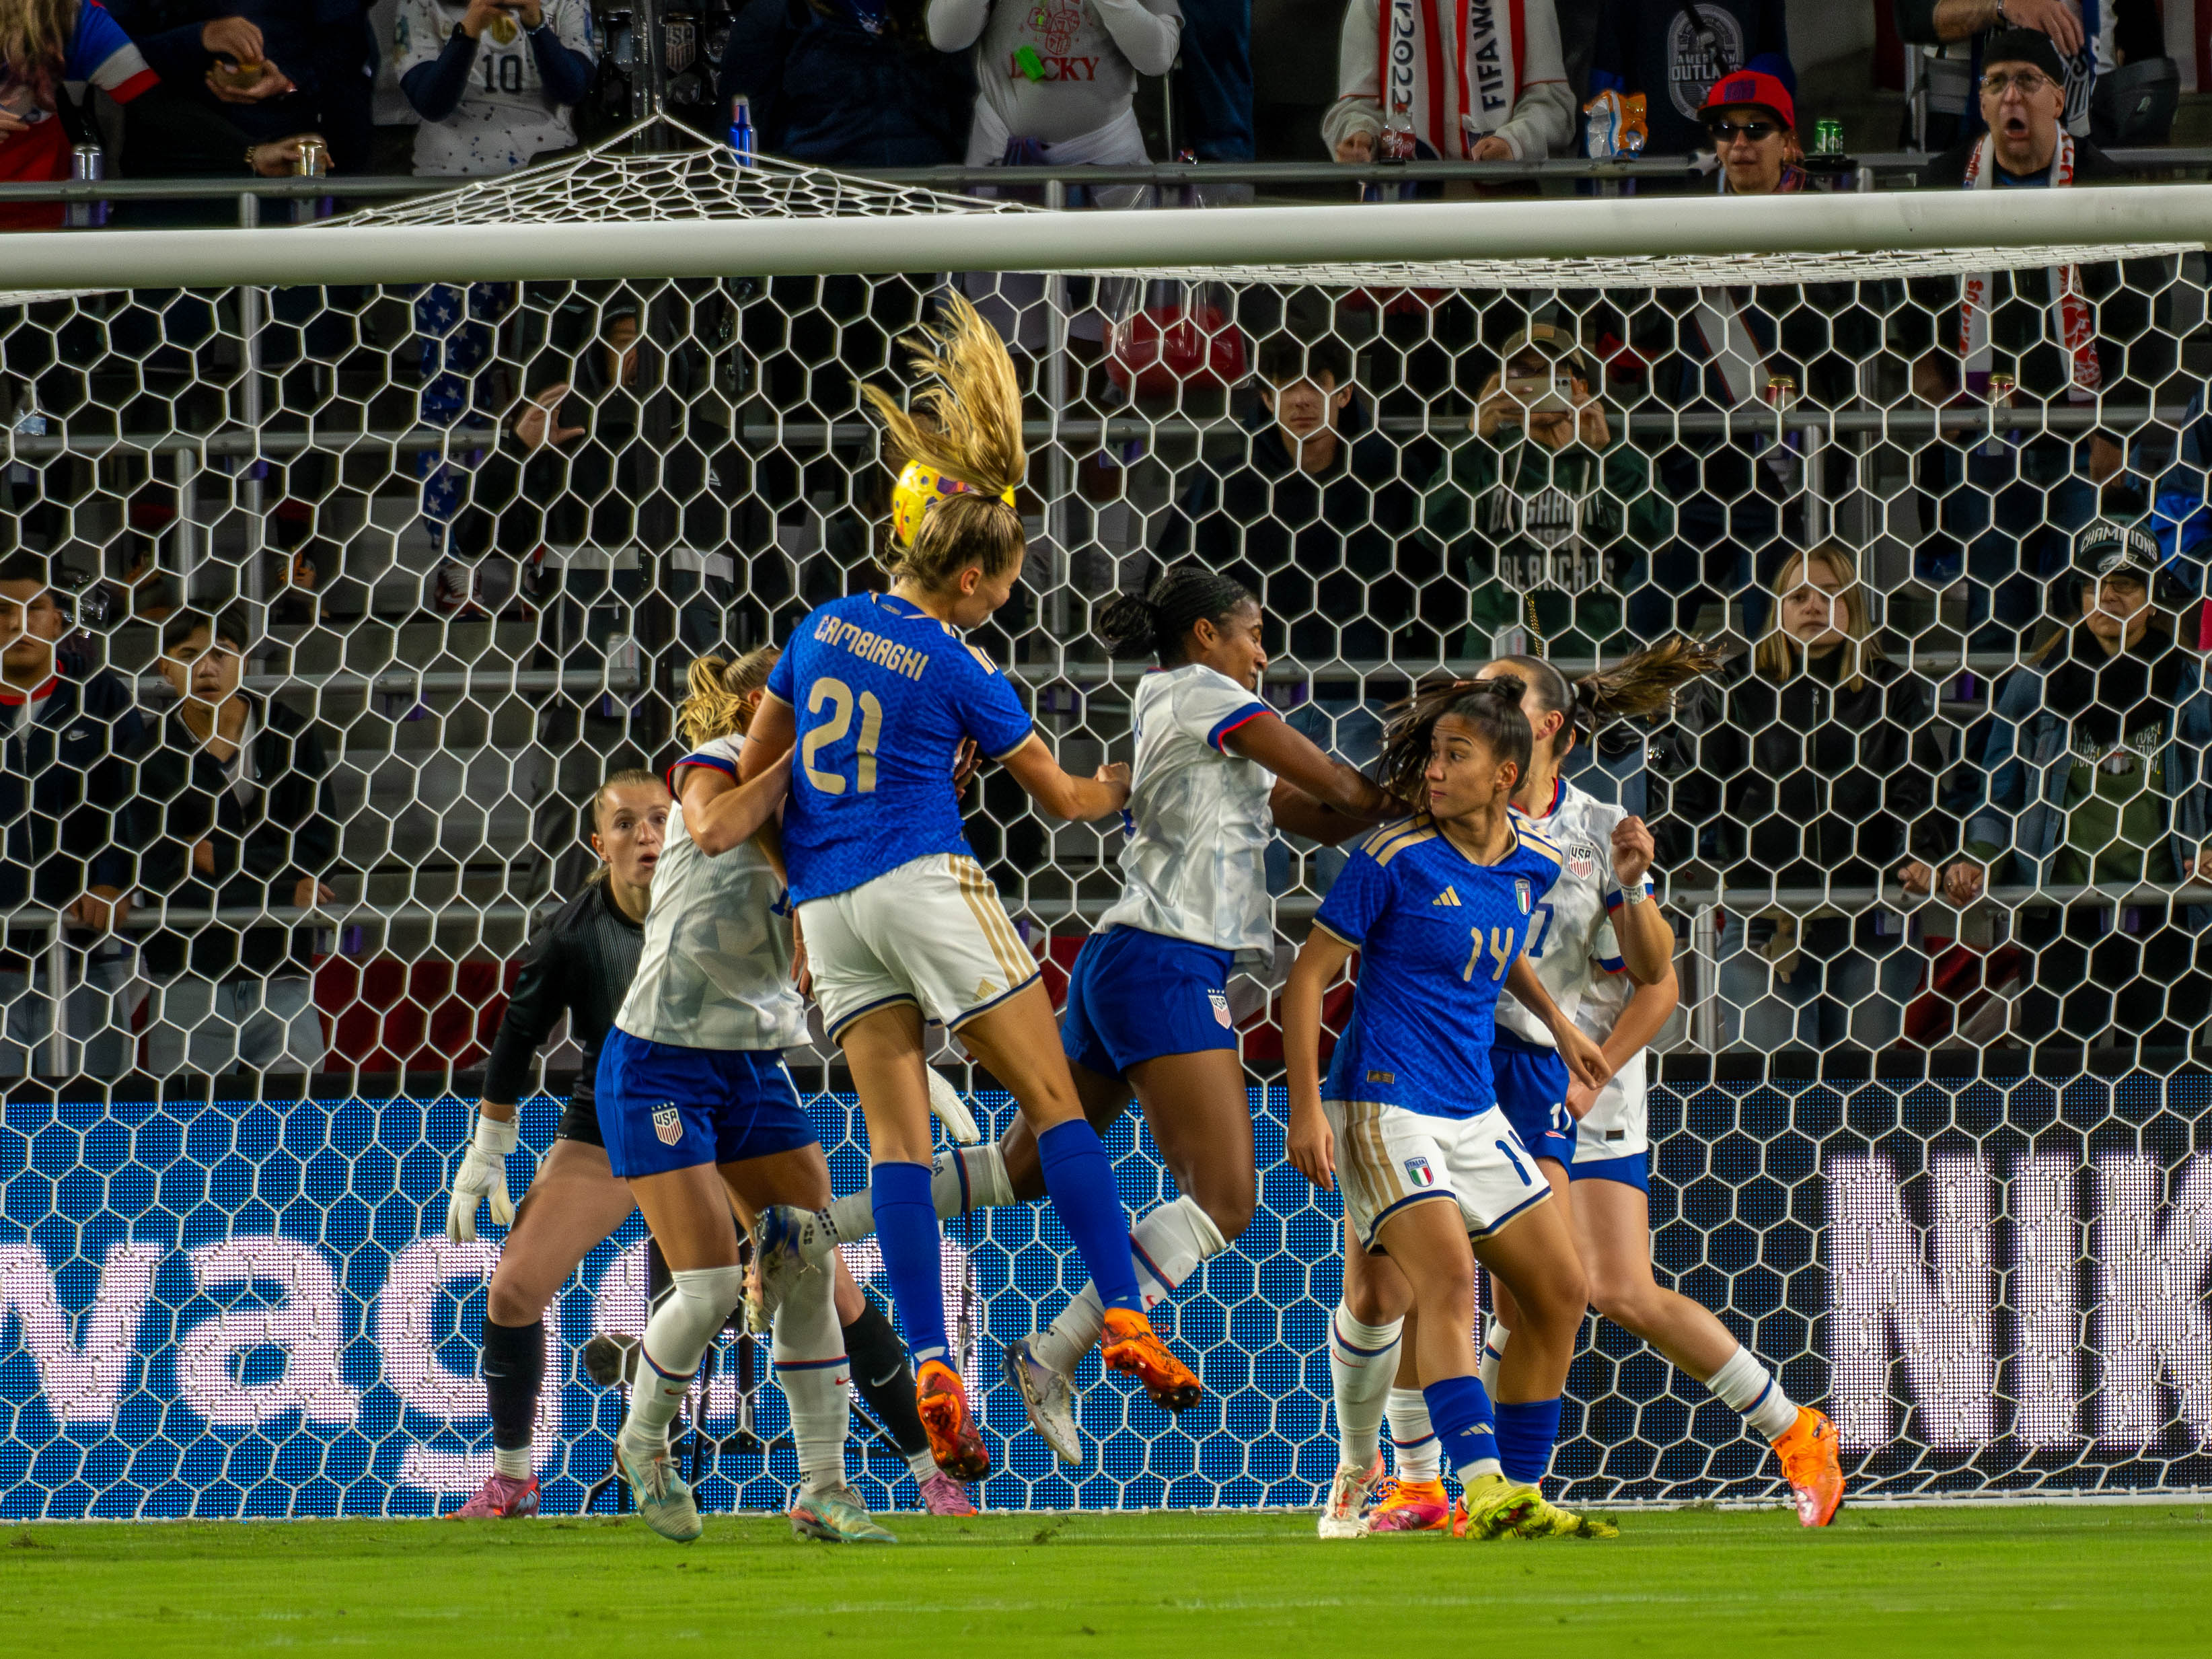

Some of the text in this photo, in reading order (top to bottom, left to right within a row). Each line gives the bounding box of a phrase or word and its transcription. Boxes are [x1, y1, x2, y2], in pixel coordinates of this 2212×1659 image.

[482, 54, 523, 94] 10
[1009, 54, 1101, 81] LCKY
[1475, 38, 1506, 112] FIFA
[1671, 64, 1744, 81] OUTLA
[1676, 52, 1740, 65] AMERAN
[2080, 526, 2158, 562] CHAMPIONS
[1501, 554, 1615, 594] BEARCATS
[813, 615, 930, 682] CAMBIAGHI
[802, 677, 883, 795] 21
[1571, 846, 1592, 860] USA
[1463, 926, 1514, 982] 14
[1211, 997, 1226, 1010] USA
[655, 1110, 677, 1126] USA
[1406, 1158, 1426, 1169] ITALIA
[1826, 1152, 2212, 1450] NIK
